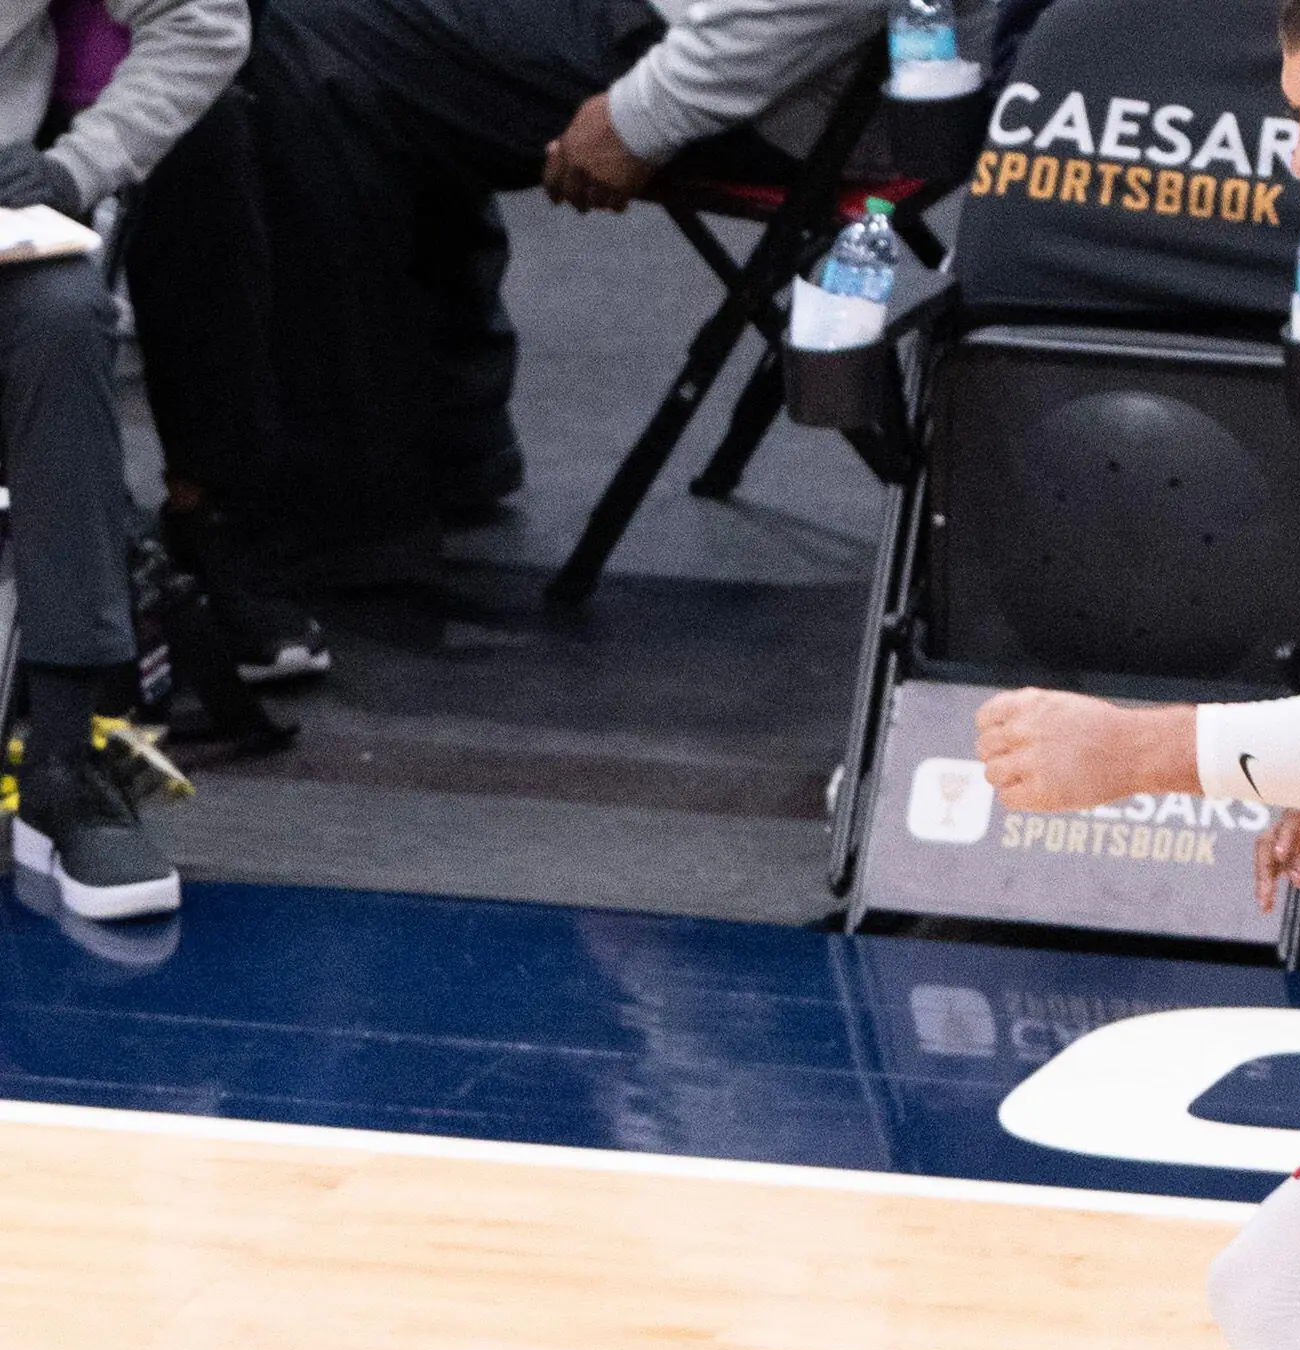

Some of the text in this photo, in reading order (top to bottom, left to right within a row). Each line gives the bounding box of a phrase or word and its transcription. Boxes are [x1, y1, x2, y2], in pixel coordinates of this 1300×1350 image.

[988, 82, 1300, 179] CAESAR
[970, 151, 1285, 226] SPORTSBOOK
[1000, 812, 1219, 865] SPORTSBOOK
